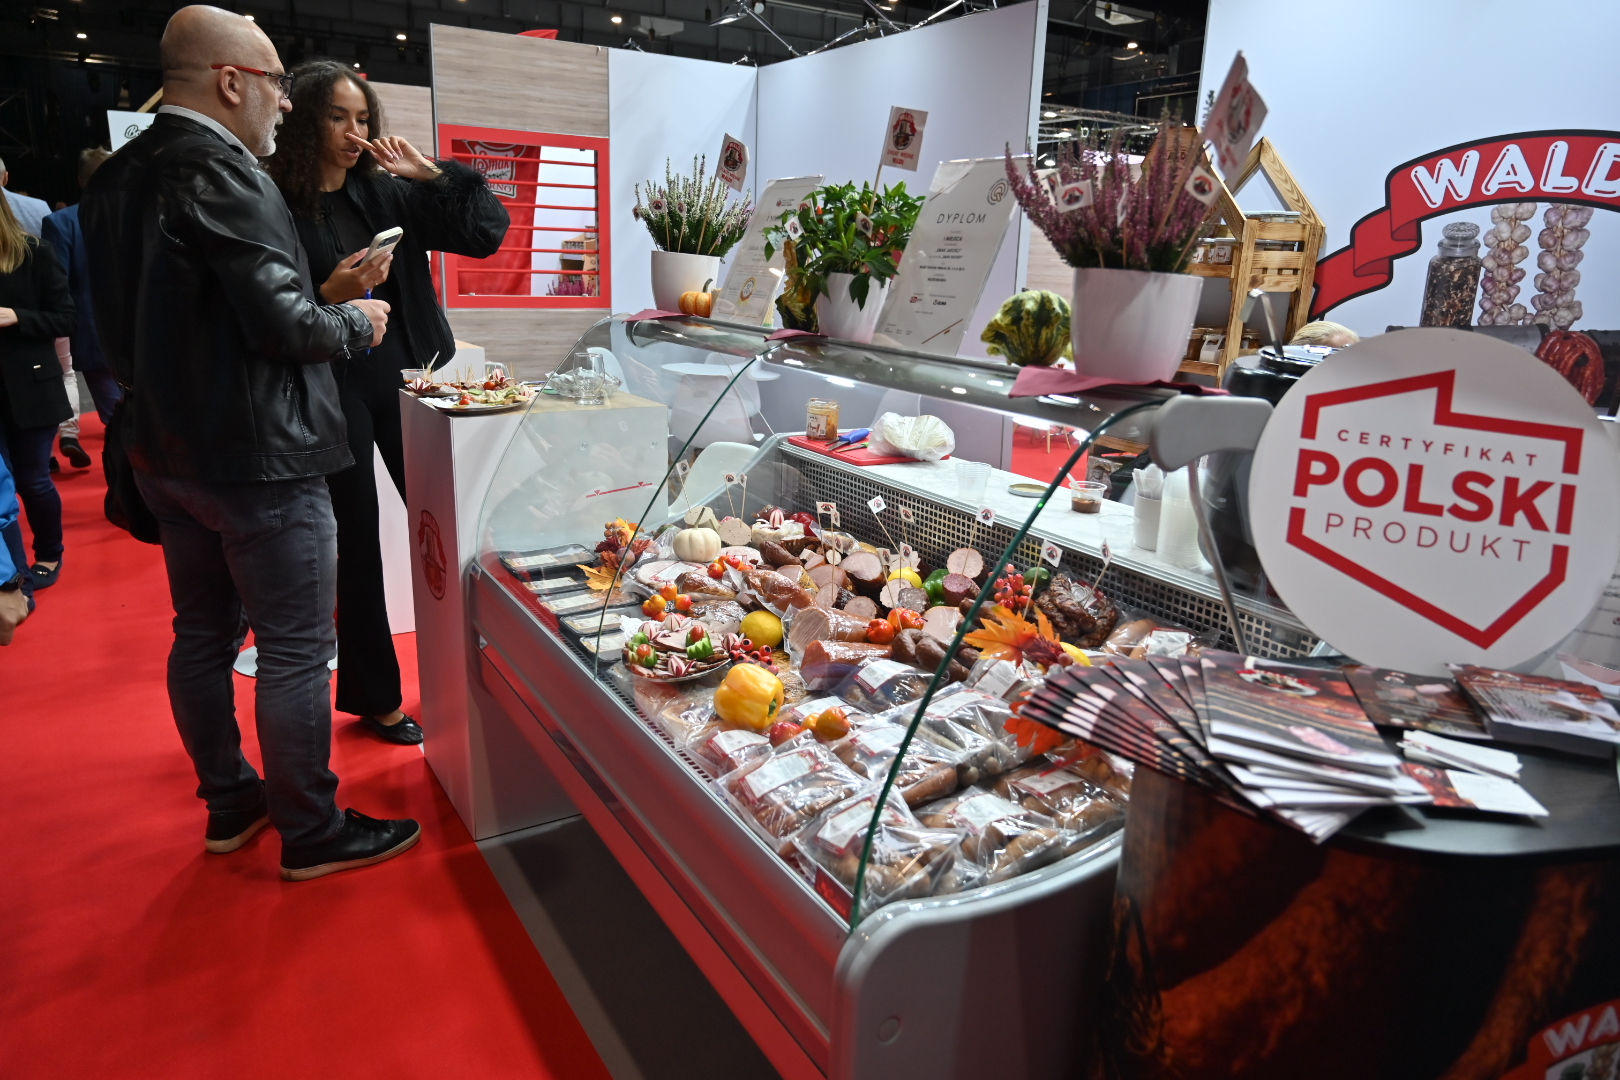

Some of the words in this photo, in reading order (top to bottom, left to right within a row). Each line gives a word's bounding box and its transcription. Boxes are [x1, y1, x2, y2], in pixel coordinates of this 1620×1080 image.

[936, 212, 987, 224] DYPLOM
[1337, 429, 1538, 467] CERTYFIKAT
[1292, 448, 1577, 536] POLSKI
[1325, 512, 1532, 562] PRODUKT
